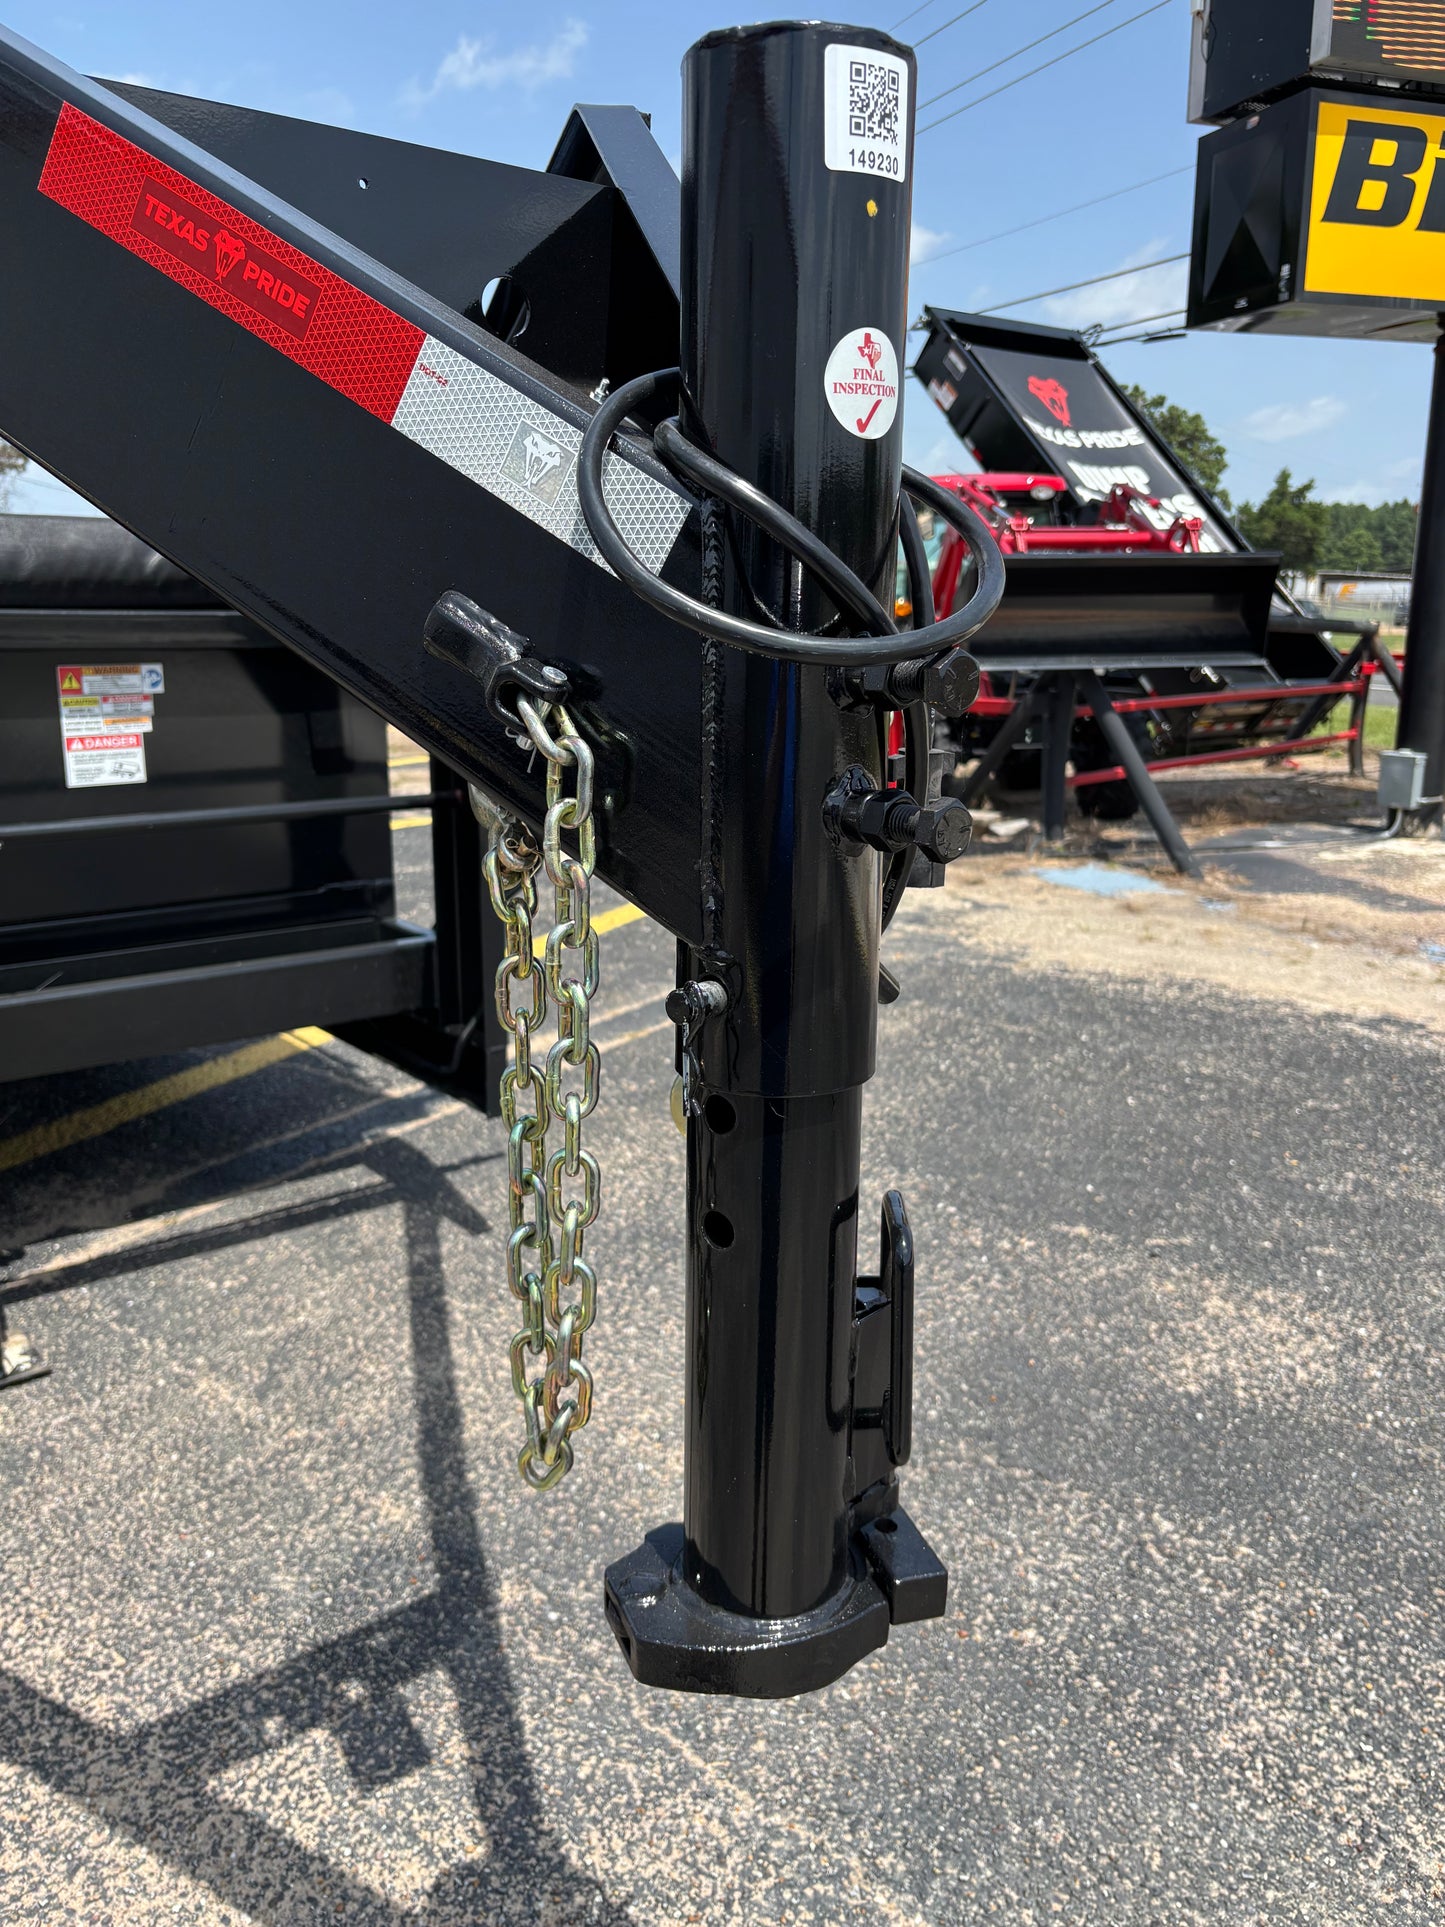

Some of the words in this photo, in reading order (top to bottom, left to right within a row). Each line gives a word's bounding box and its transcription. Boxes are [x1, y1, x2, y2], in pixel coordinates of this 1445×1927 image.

[848, 148, 899, 176] 149230
[145, 193, 211, 252] TEXAS
[242, 259, 311, 319] PRIDE
[419, 362, 448, 387] DOT-C2
[853, 368, 885, 382] FINAL
[833, 382, 896, 398] INSPECTION
[1078, 427, 1145, 449] PRIDE
[84, 736, 137, 749] DANGER
